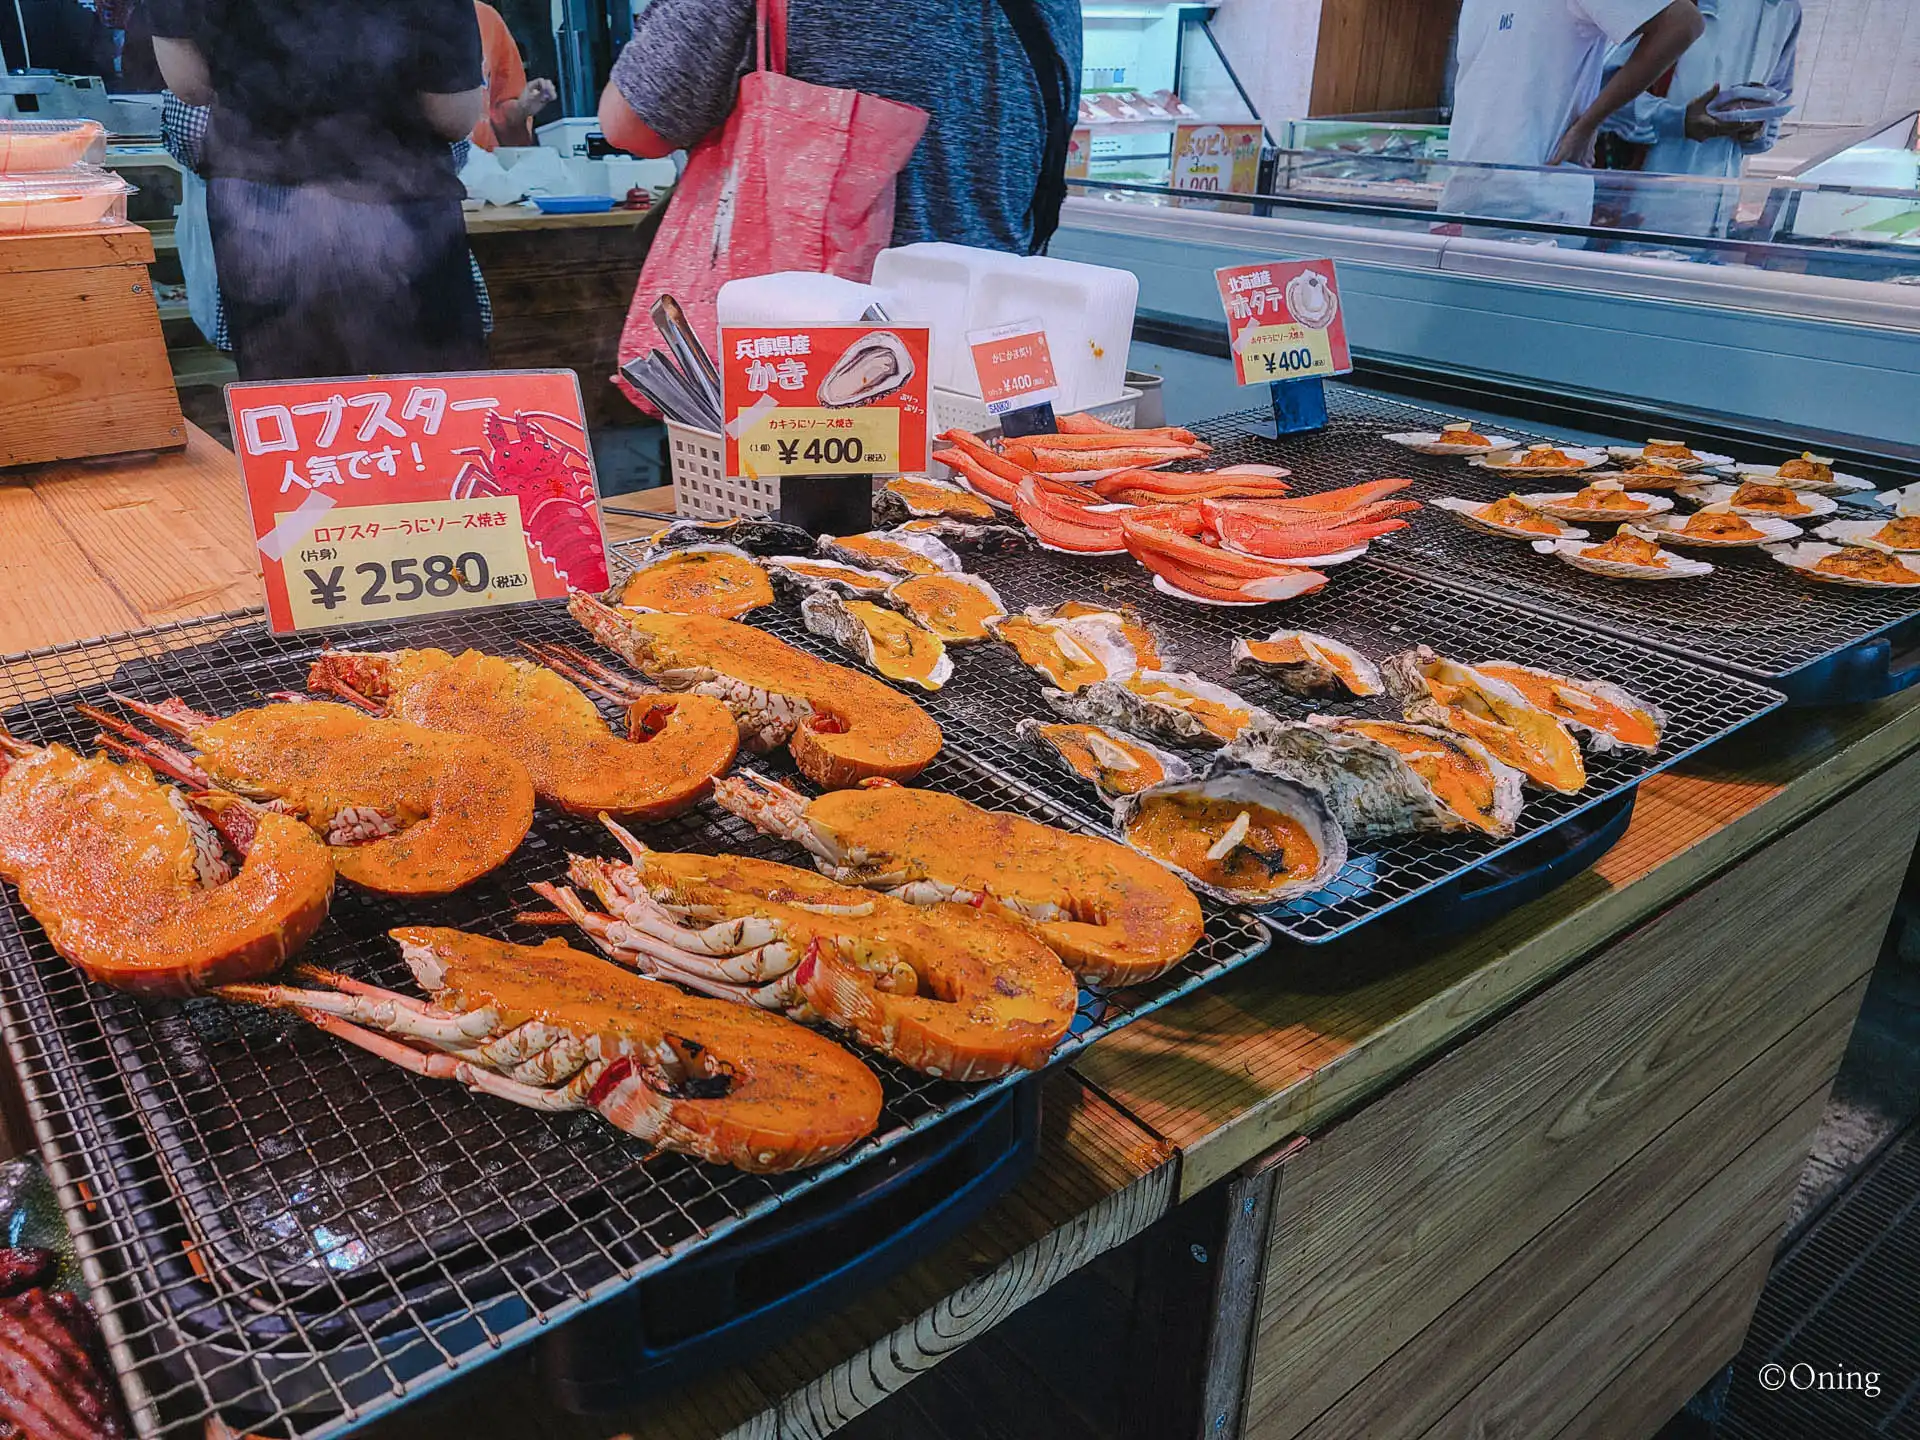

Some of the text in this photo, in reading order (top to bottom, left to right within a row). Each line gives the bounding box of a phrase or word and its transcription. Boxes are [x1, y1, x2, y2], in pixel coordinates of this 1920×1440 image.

[1228, 270, 1272, 293] 北海道産
[1231, 287, 1283, 319] ホタテ
[735, 334, 812, 360] 兵庫県産
[1262, 347, 1312, 374] ¥400
[745, 358, 809, 392] かき
[1002, 374, 1032, 392] ¥400
[240, 386, 500, 456] ロブスター
[769, 418, 855, 430] カキうにソース焼き
[777, 437, 863, 465] ¥400
[279, 441, 426, 494] 人気です!
[313, 511, 509, 544] ロブスターうにソース焼き
[303, 551, 489, 611] ¥2580
